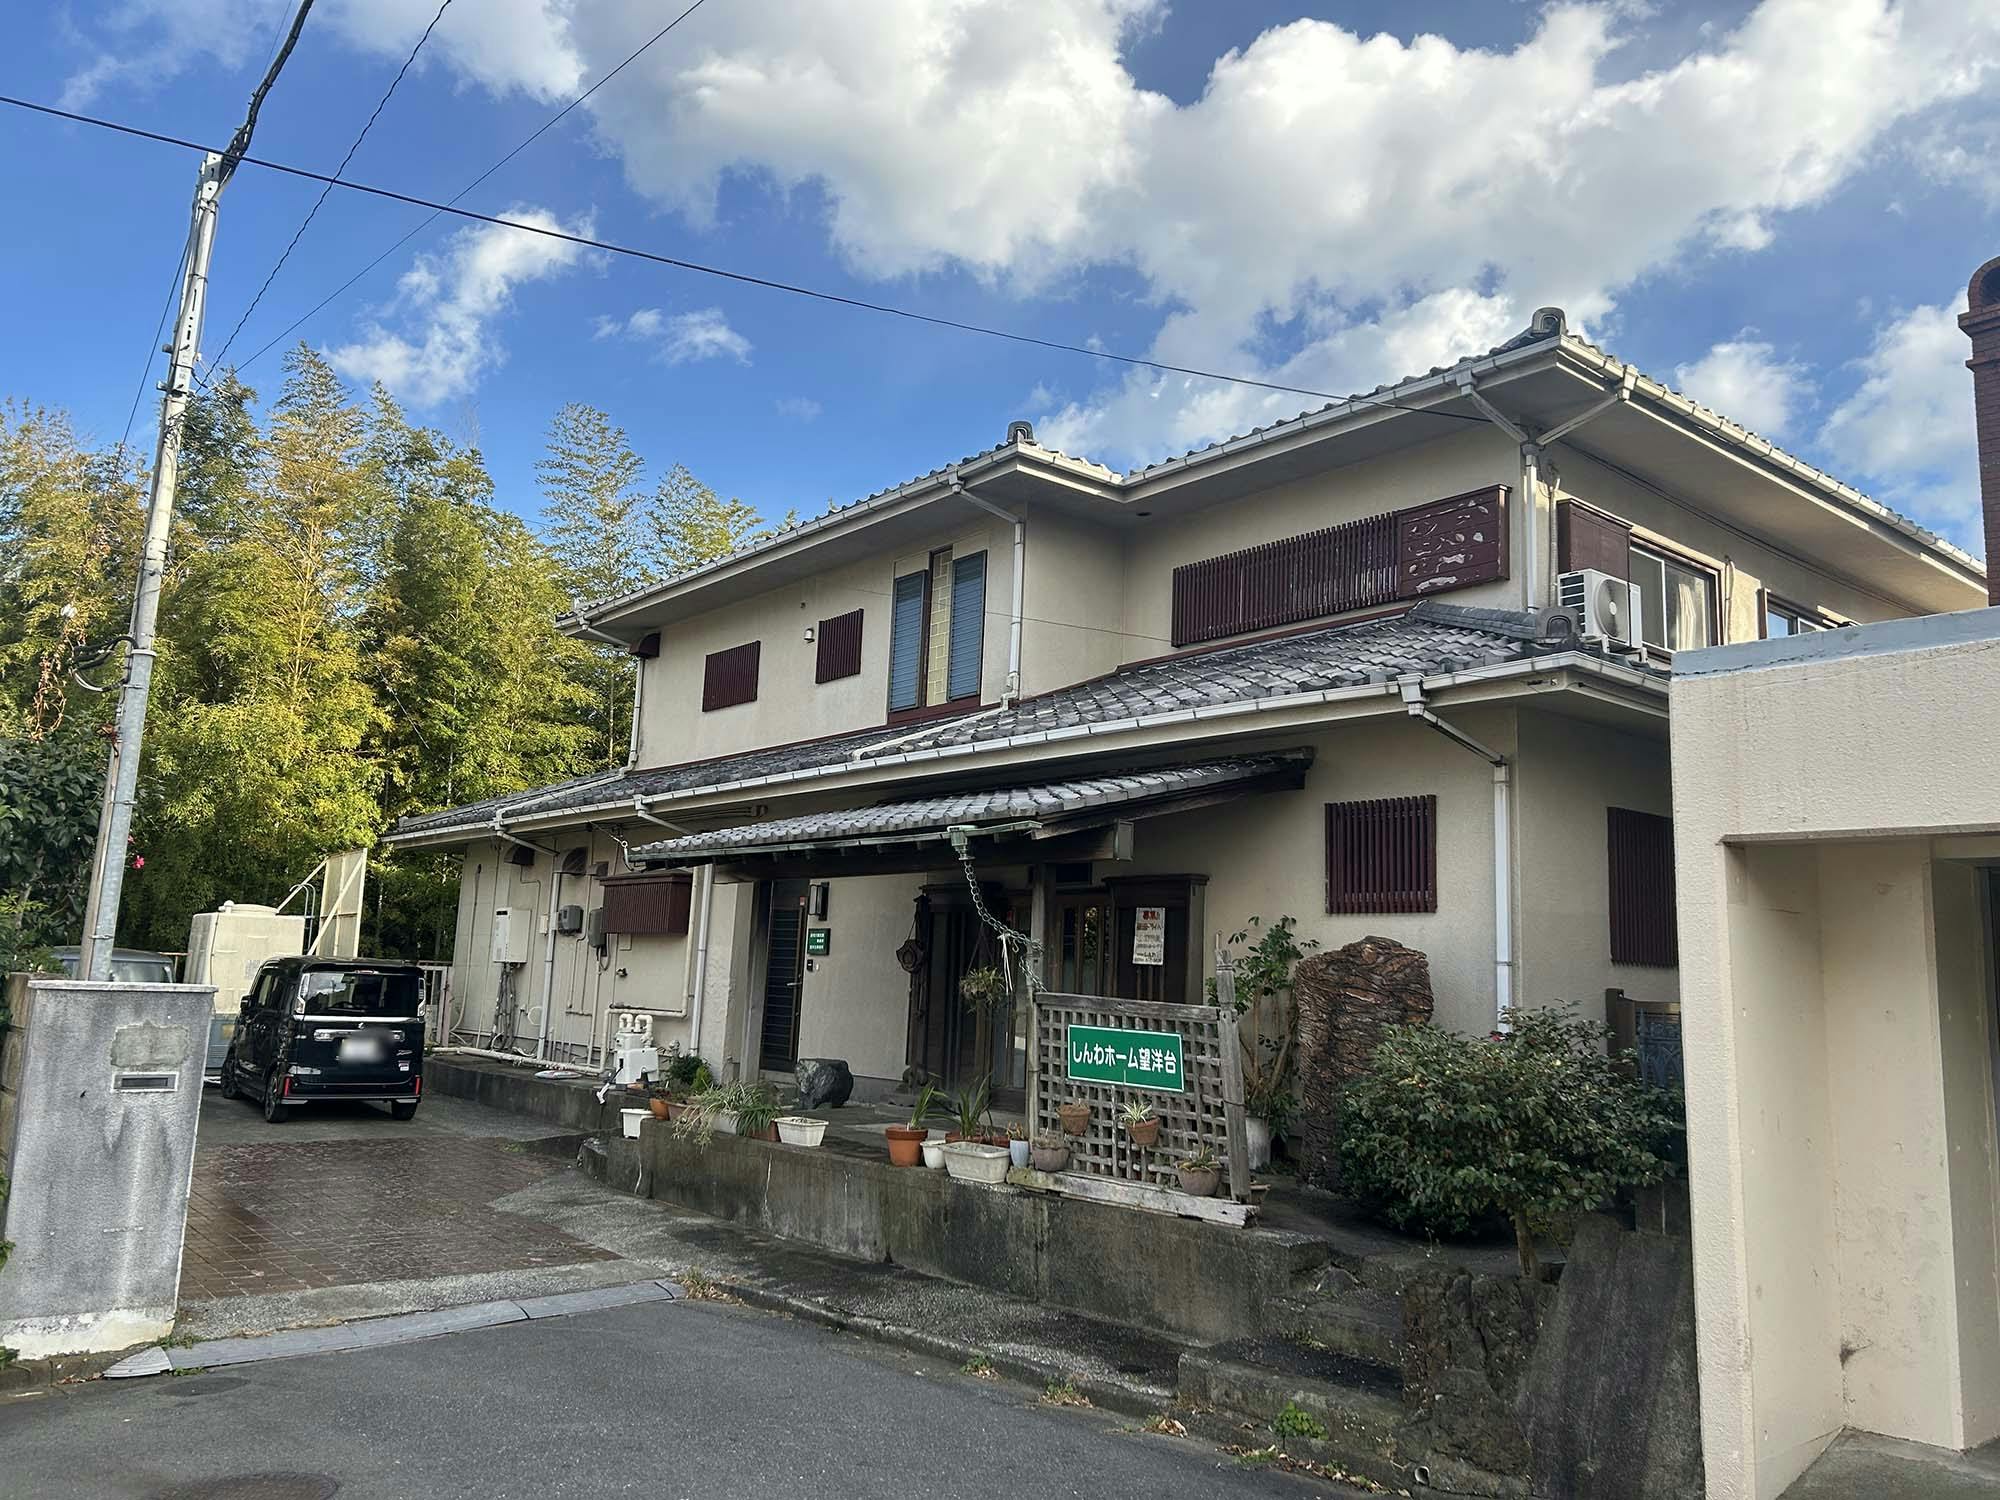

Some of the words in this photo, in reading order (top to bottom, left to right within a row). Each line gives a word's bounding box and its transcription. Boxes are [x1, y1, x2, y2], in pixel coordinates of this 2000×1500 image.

[1073, 1041, 1177, 1074] しんわホーム望洋台
